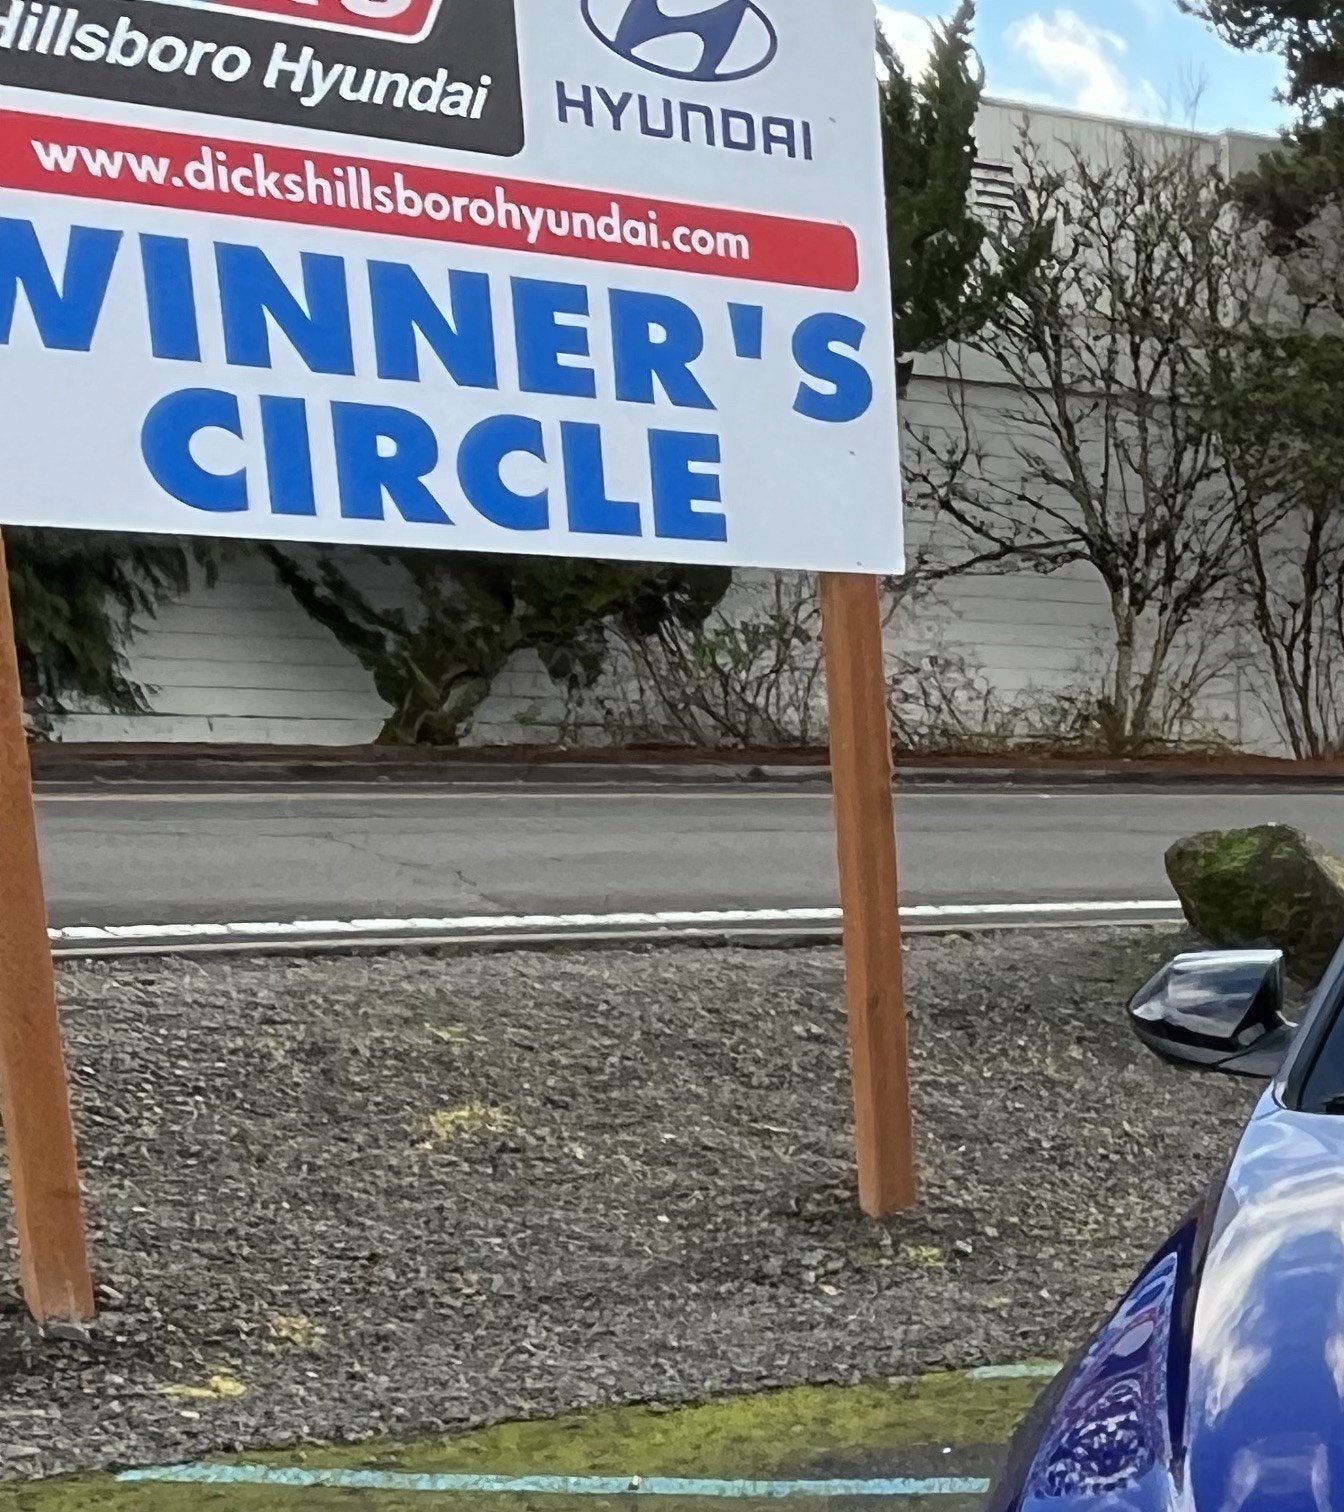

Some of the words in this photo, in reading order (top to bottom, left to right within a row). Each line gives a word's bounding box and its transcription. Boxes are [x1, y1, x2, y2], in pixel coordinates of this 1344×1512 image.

[263, 42, 492, 119] Hyundai
[557, 81, 812, 161] HYUNDAI
[31, 138, 750, 262] www.dickshillsborohyundai.com
[0, 216, 874, 423] WINNER'S
[140, 388, 728, 542] CIRCLE
